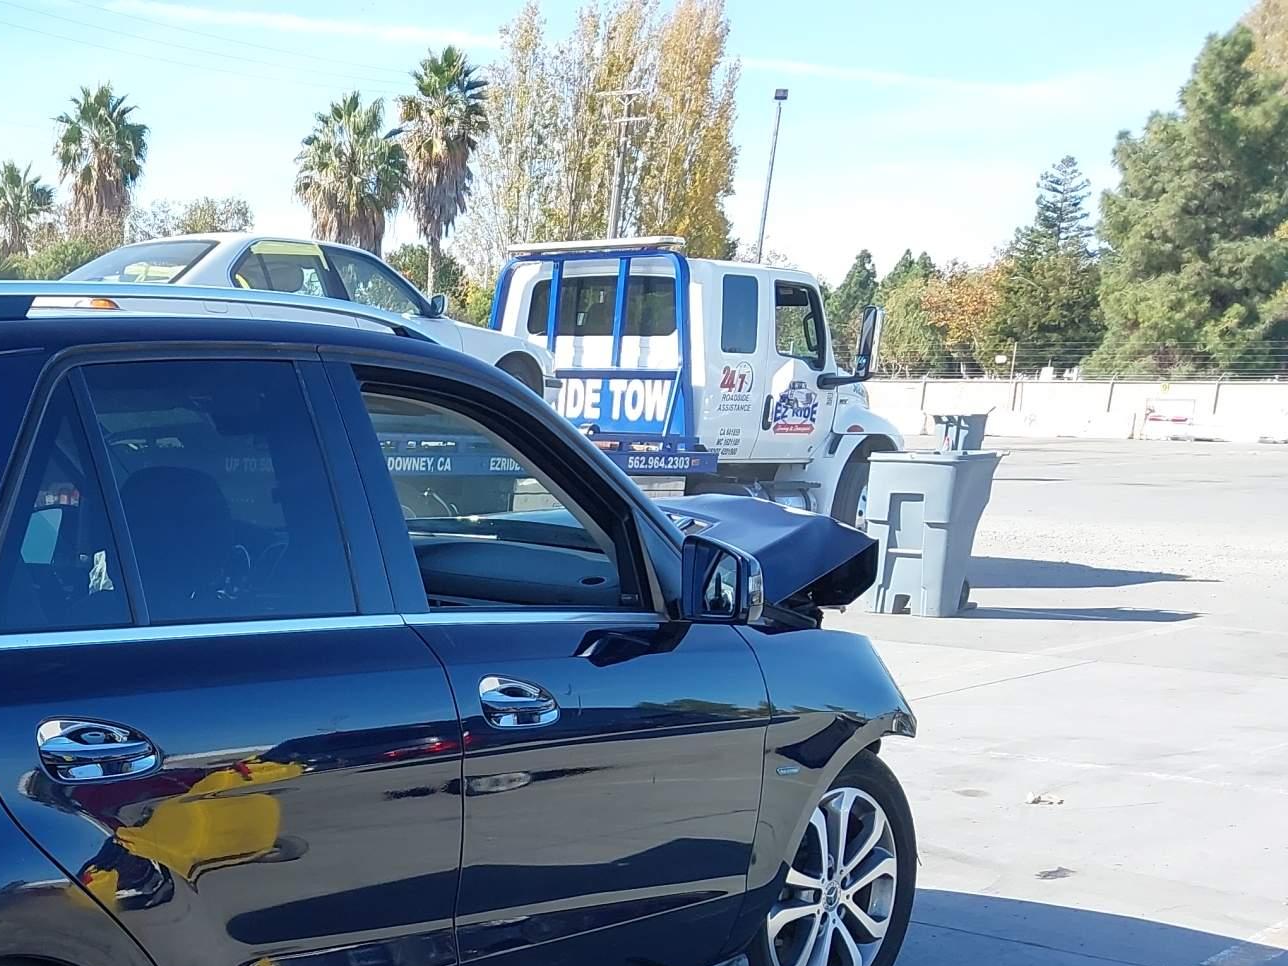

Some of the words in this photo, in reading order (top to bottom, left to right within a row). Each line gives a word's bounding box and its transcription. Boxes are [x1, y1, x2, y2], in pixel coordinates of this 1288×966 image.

[552, 378, 603, 420] IDE
[609, 379, 672, 421] TOW
[721, 394, 750, 402] ROADSIDE
[717, 404, 752, 412] ASSISTANCE
[774, 401, 789, 422] EZ
[792, 402, 818, 423] RIDE
[388, 457, 434, 472] DOWNEY,
[437, 457, 452, 471] CA
[628, 456, 690, 469] 562.964.2303
